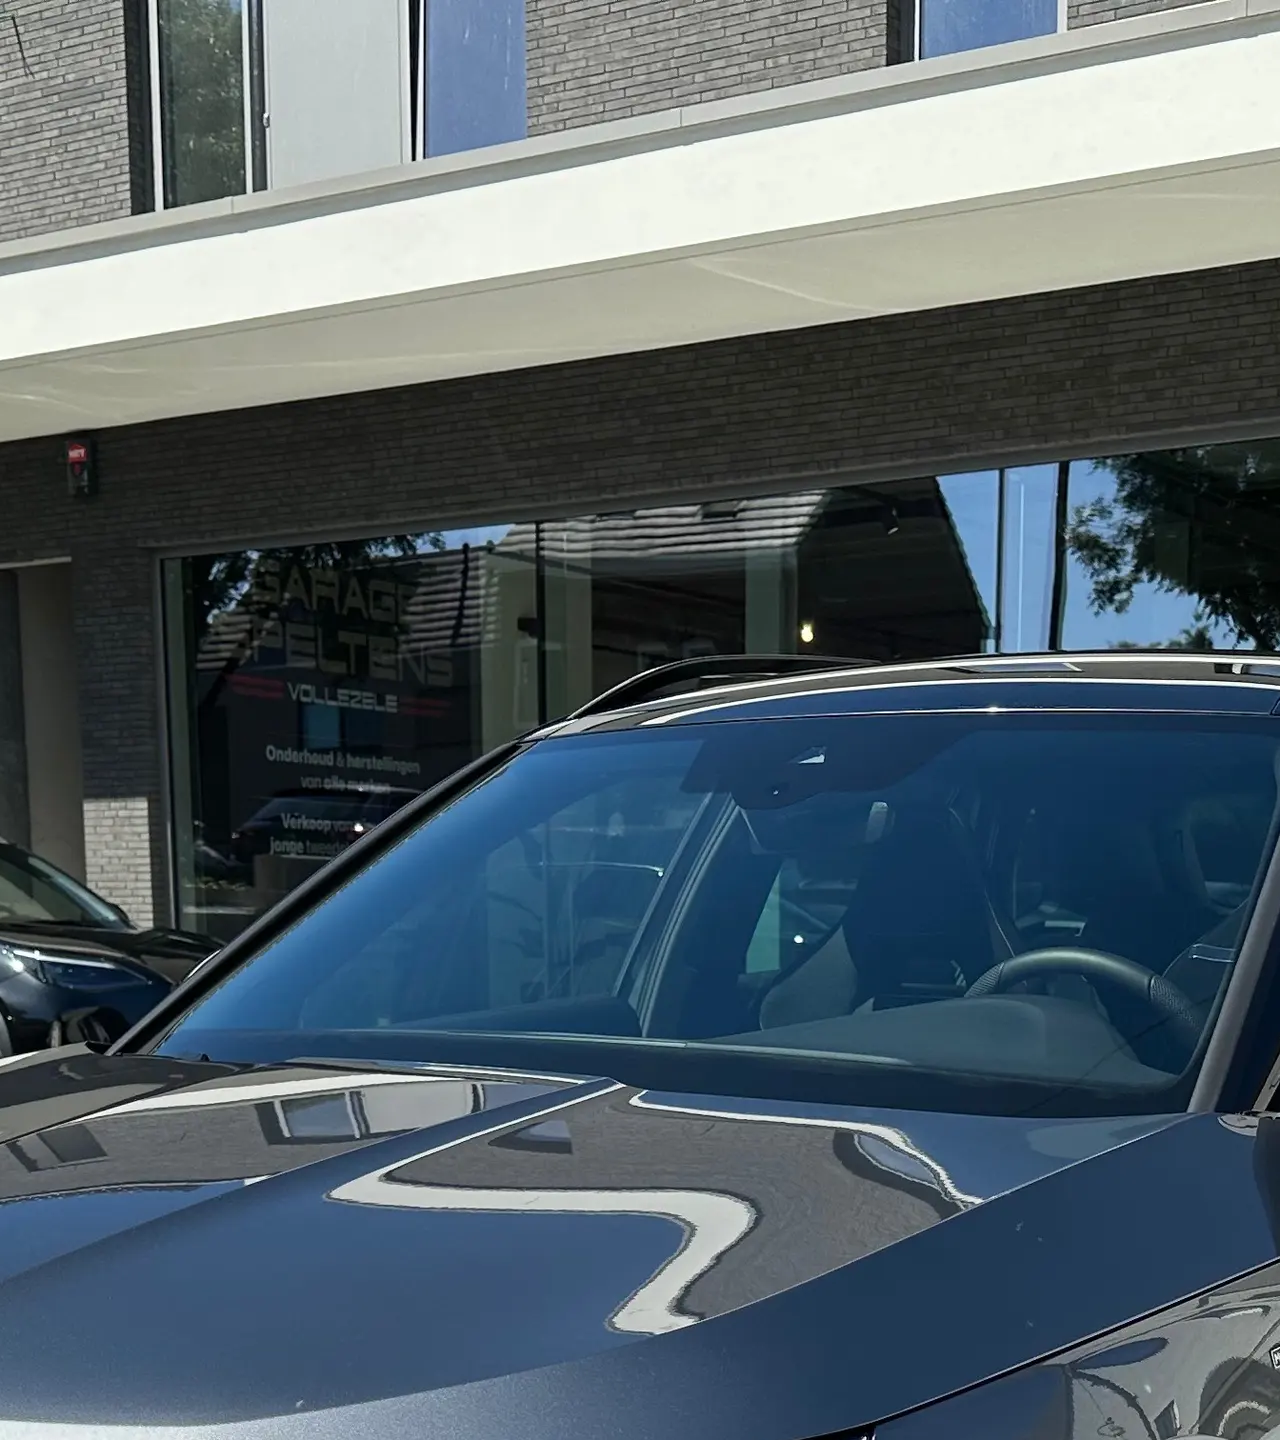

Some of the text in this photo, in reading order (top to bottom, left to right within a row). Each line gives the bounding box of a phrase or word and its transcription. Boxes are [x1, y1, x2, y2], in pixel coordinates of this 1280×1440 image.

[230, 609, 454, 688] PELTENS
[286, 681, 399, 714] VOLLEZELE
[266, 745, 422, 776] Onderhoud & herstellingen
[280, 812, 331, 834] Verkoop
[270, 836, 305, 856] jonge
